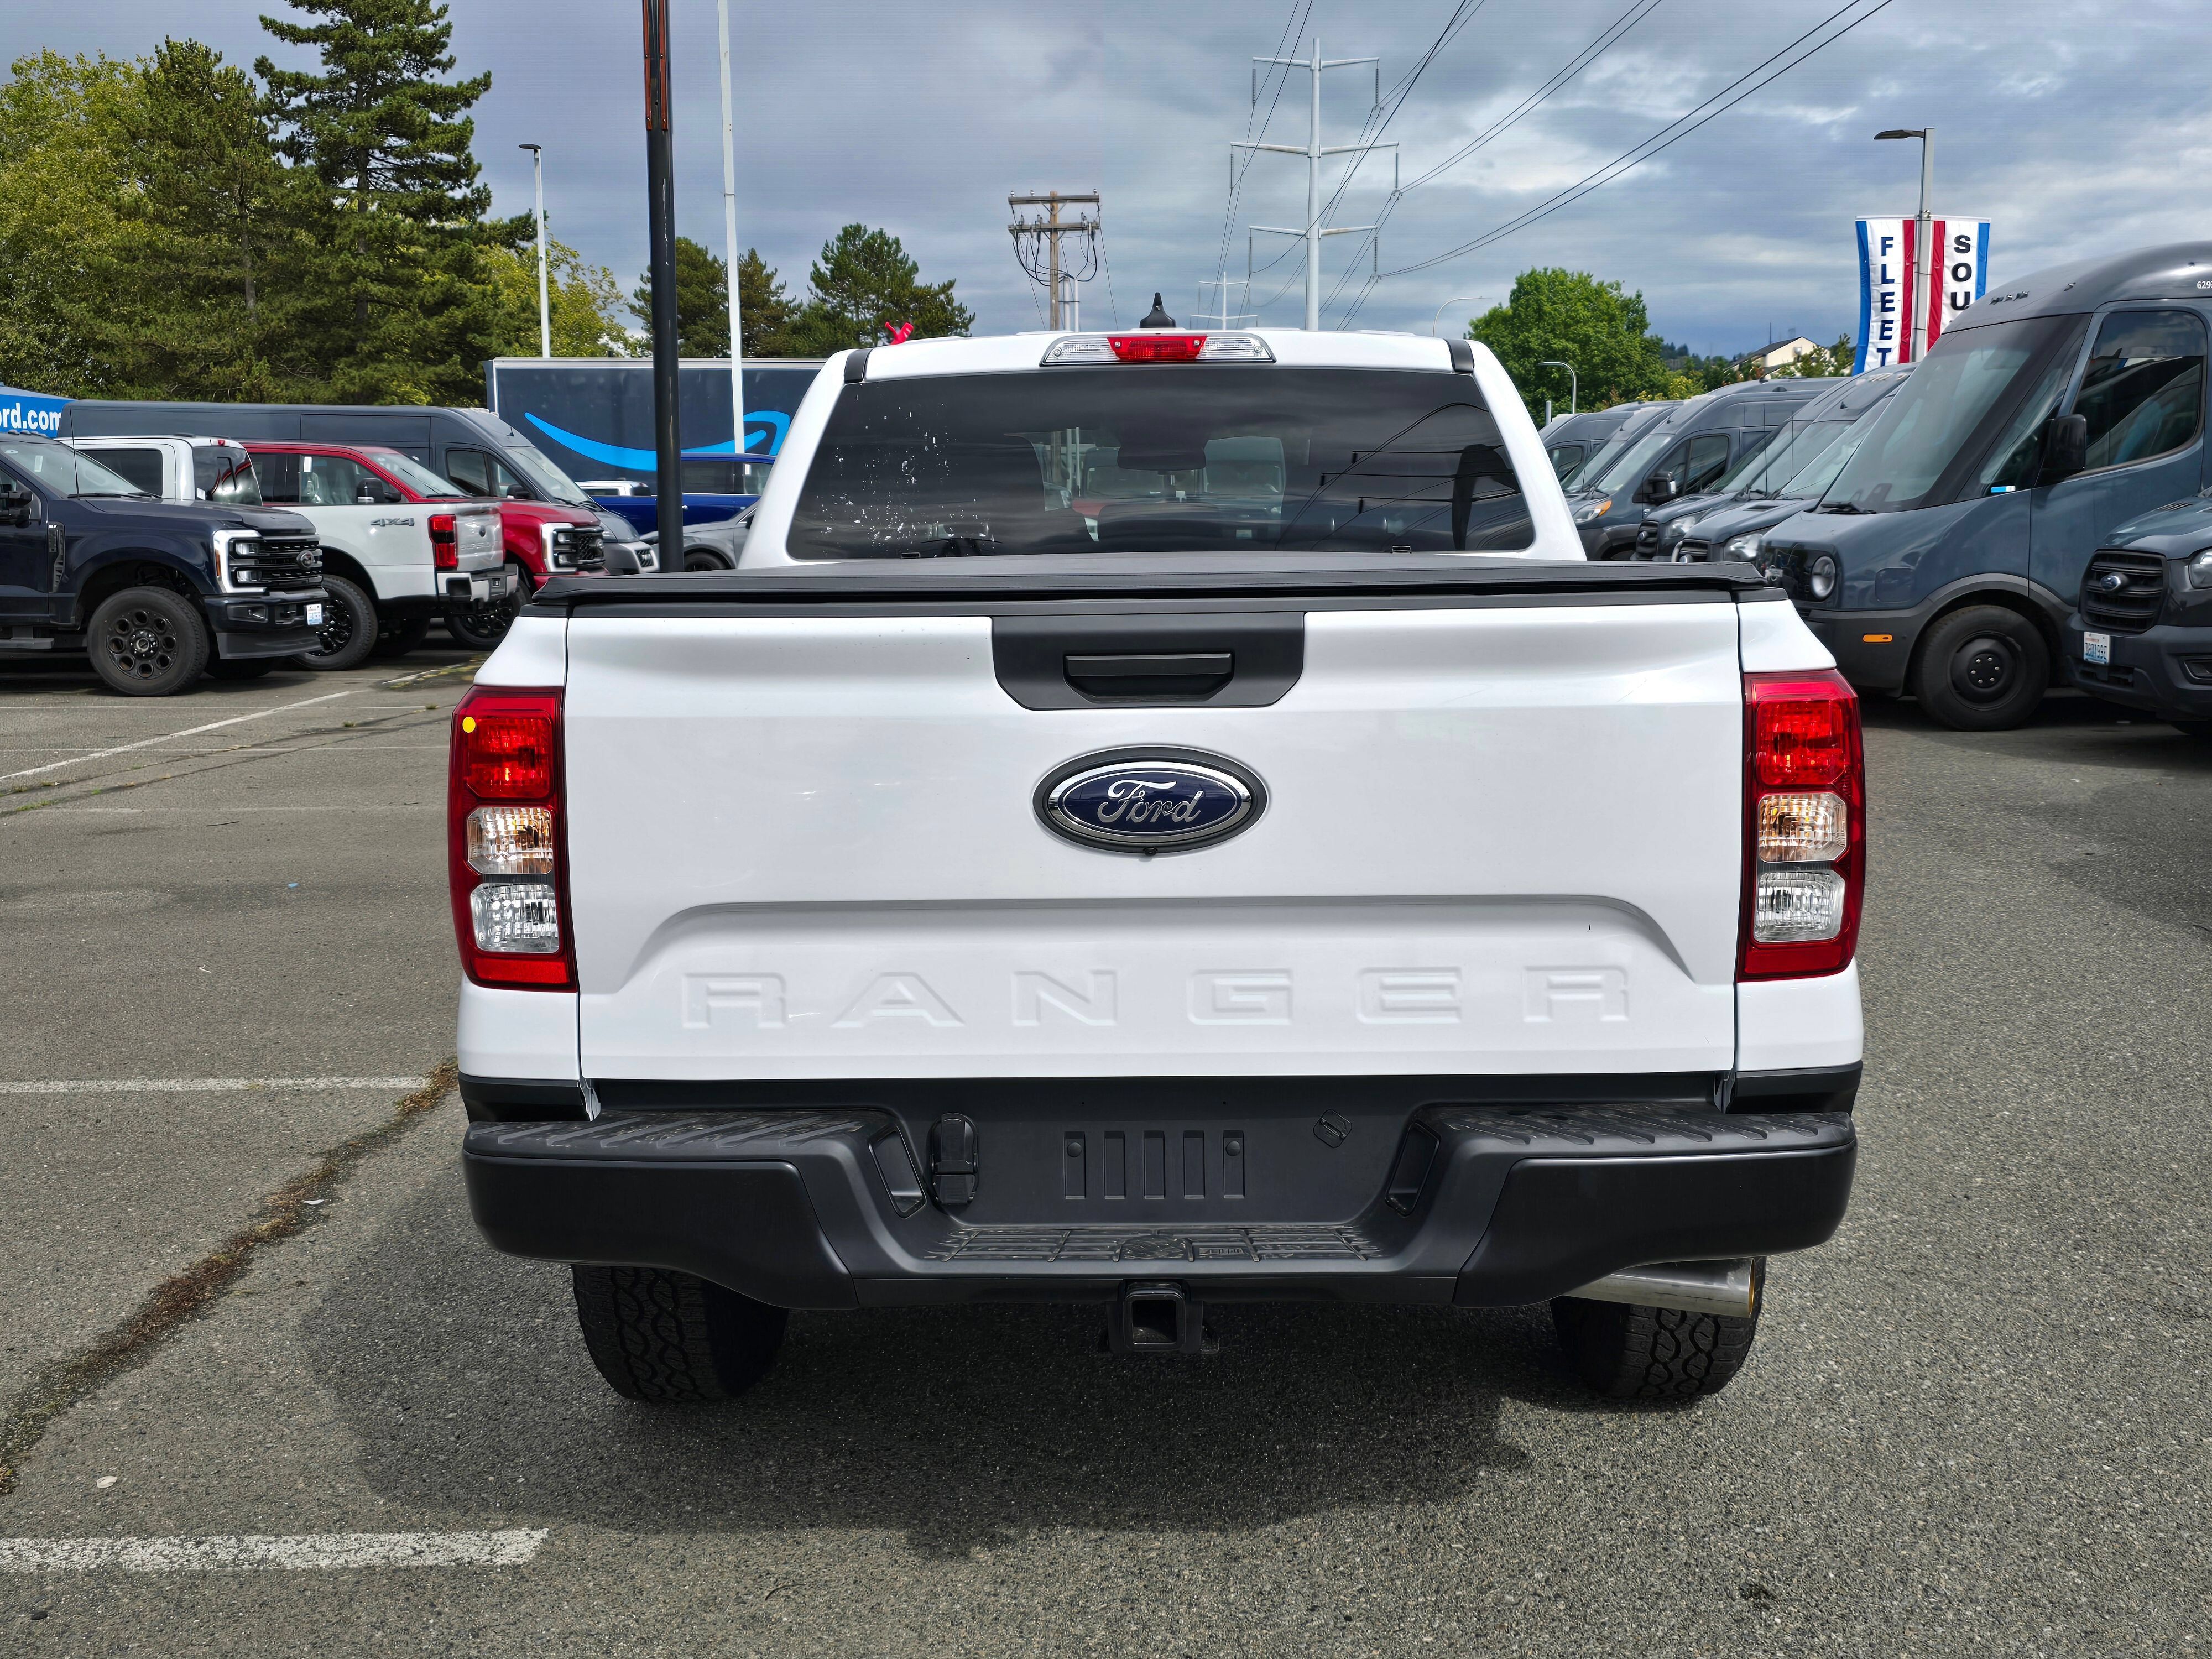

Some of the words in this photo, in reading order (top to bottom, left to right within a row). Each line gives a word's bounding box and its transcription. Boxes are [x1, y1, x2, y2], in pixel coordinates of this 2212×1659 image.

[1876, 236, 1896, 367] FLEET
[1949, 234, 1972, 322] SOU
[0, 402, 61, 431] rd.com
[1097, 780, 1204, 823] Ford
[681, 966, 1630, 1030] RANGER
